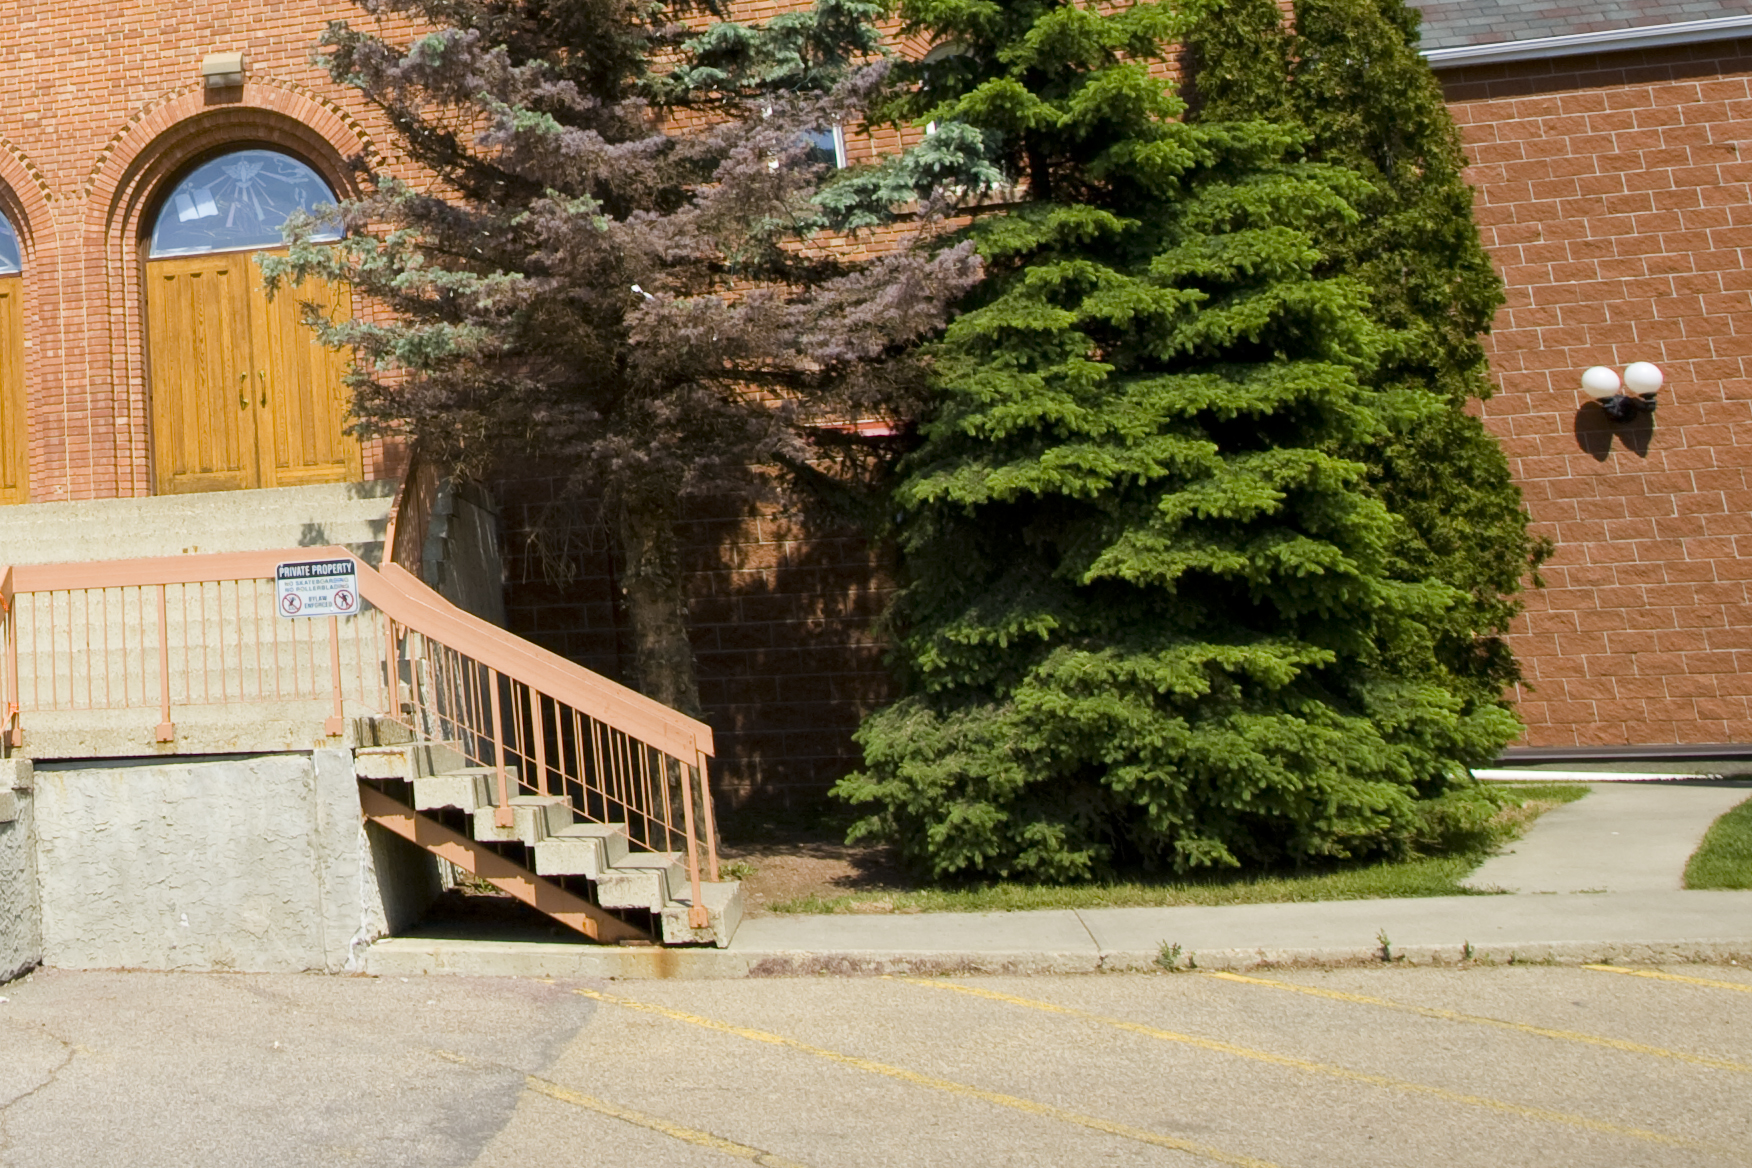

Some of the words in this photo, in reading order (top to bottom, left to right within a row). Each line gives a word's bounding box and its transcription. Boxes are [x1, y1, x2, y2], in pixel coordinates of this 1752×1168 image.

[279, 565, 311, 578] PRIVATE
[311, 562, 352, 576] PROPERTY
[304, 601, 333, 609] ENFORCED
